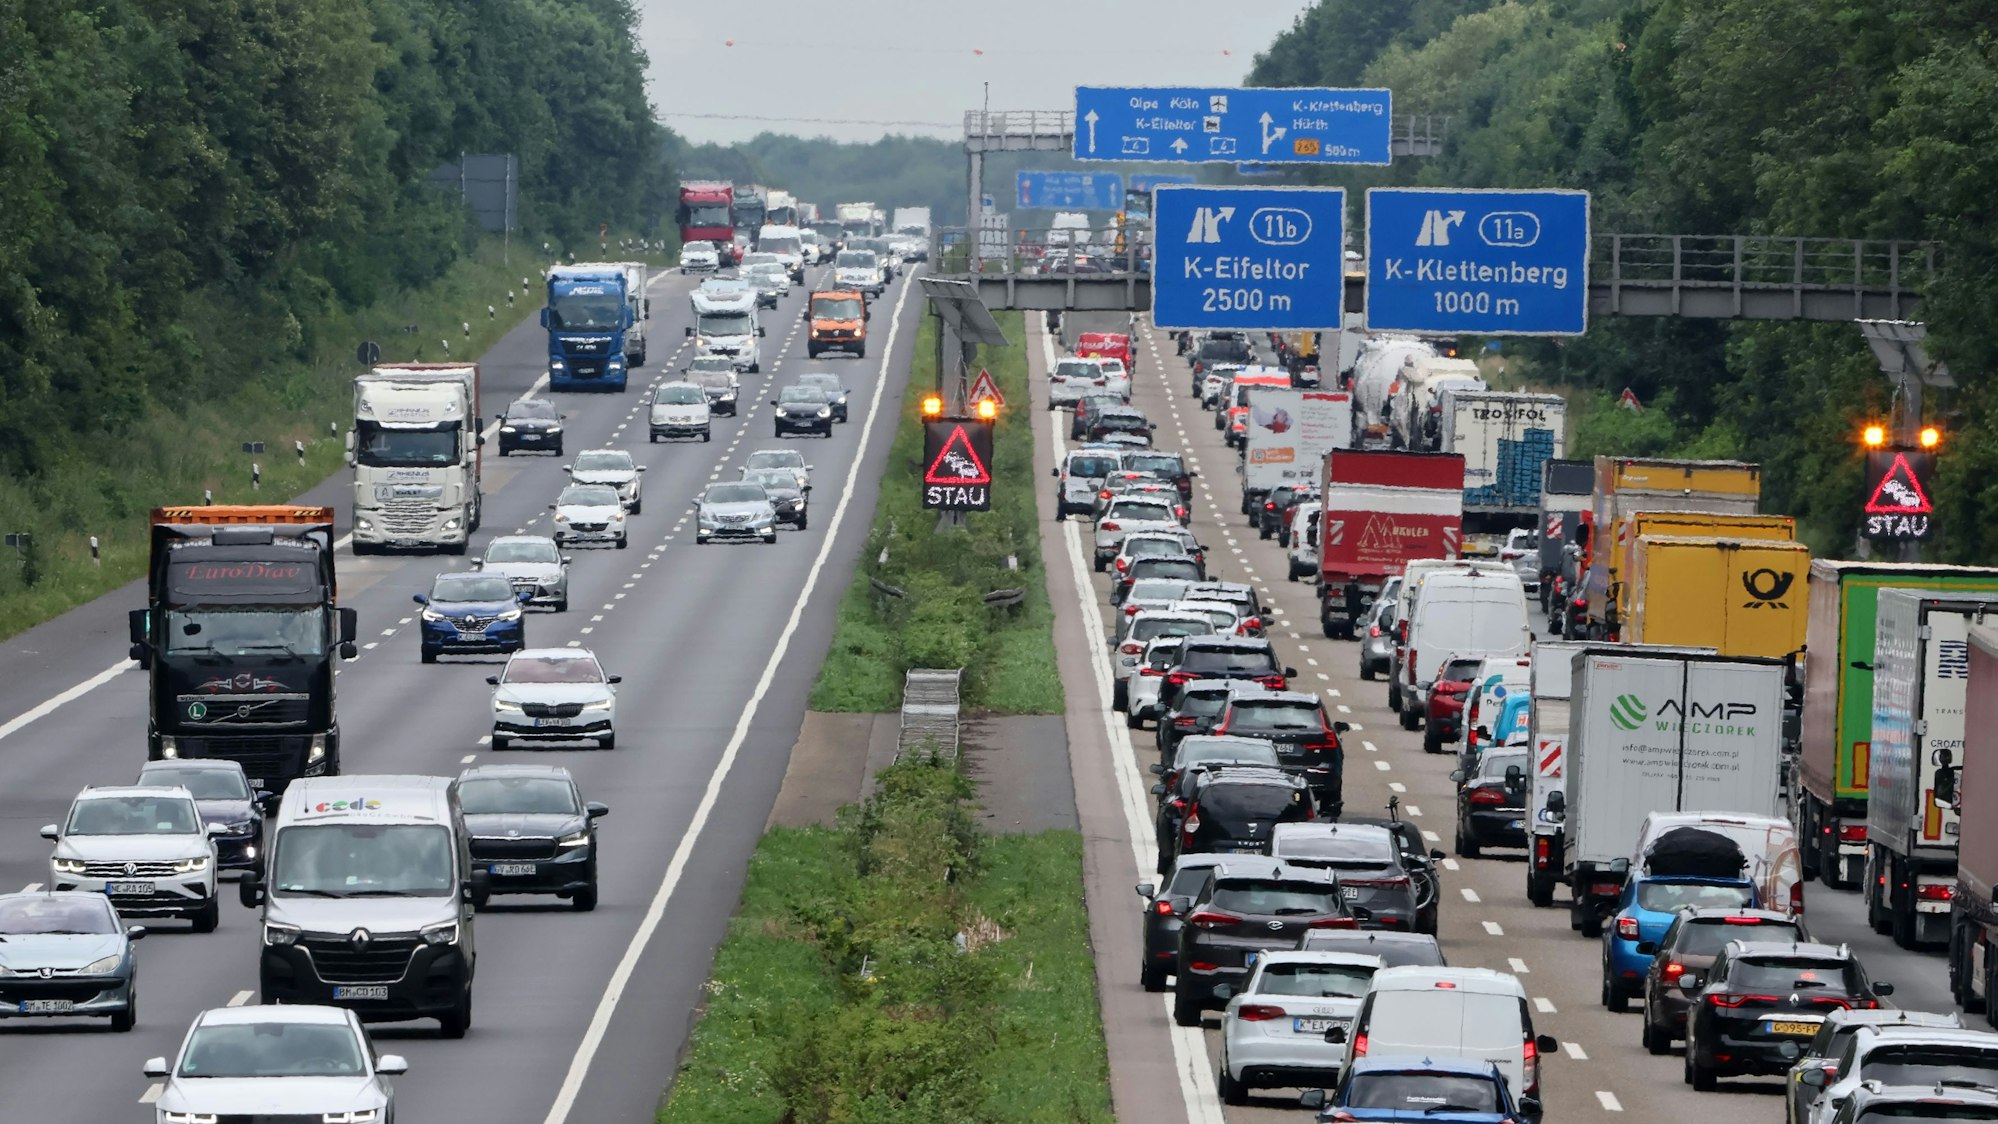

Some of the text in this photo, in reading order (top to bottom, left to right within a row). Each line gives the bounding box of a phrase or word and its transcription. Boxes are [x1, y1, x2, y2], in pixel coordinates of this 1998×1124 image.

[1130, 97, 1200, 111] Olpe Köln
[1293, 100, 1383, 115] K-Klettenberg
[1136, 118, 1196, 130] K-Eifeltor
[1293, 119, 1329, 130] Hürth
[1265, 215, 1297, 238] 11b
[1494, 218, 1524, 240] 11a
[1184, 256, 1310, 280] K-Eifeltor
[1385, 258, 1568, 289] K-Klettenberg
[1202, 288, 1291, 312] 2500 m
[1434, 291, 1519, 315] 1000 m
[927, 486, 985, 505] STAU
[1867, 514, 1928, 537] STAU
[1657, 699, 1756, 720] AMP
